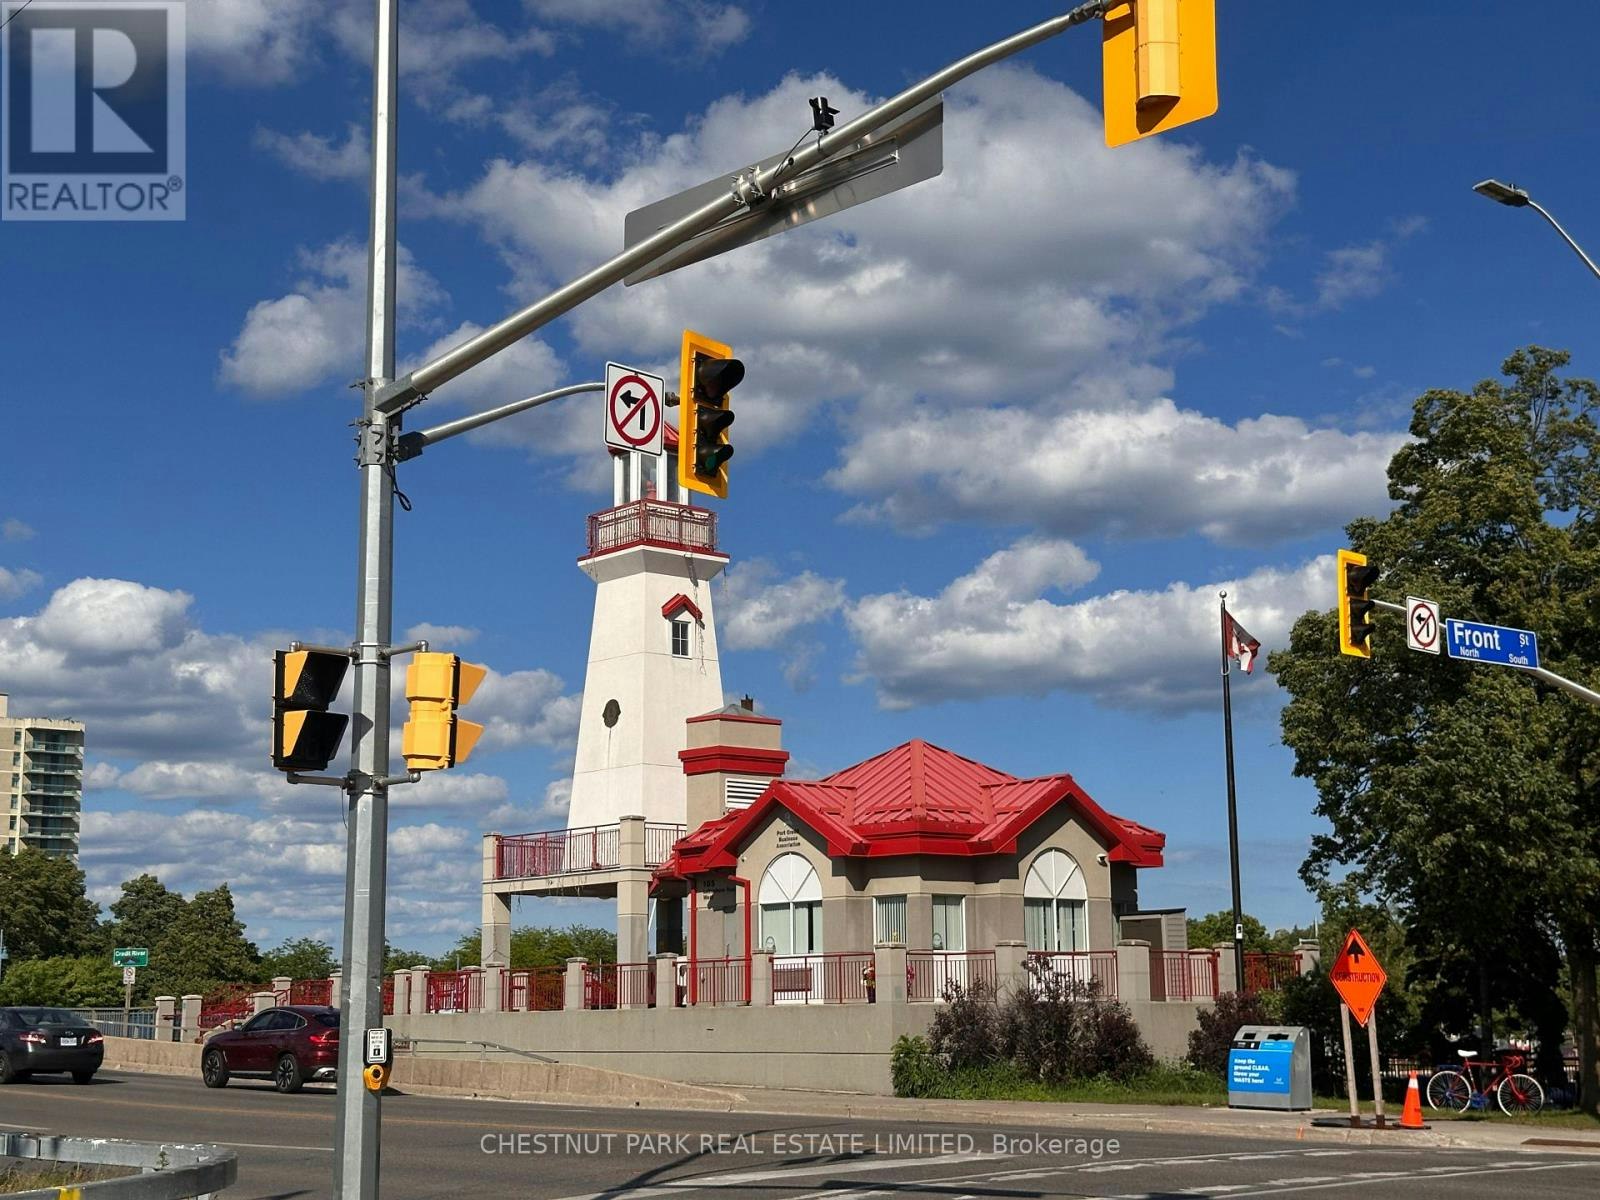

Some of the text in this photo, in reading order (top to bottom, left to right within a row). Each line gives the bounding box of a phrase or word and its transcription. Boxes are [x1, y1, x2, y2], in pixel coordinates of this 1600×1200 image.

[1453, 622, 1529, 650] Front St
[1460, 646, 1529, 665] North South
[1334, 971, 1380, 983] CONSTRUCTION
